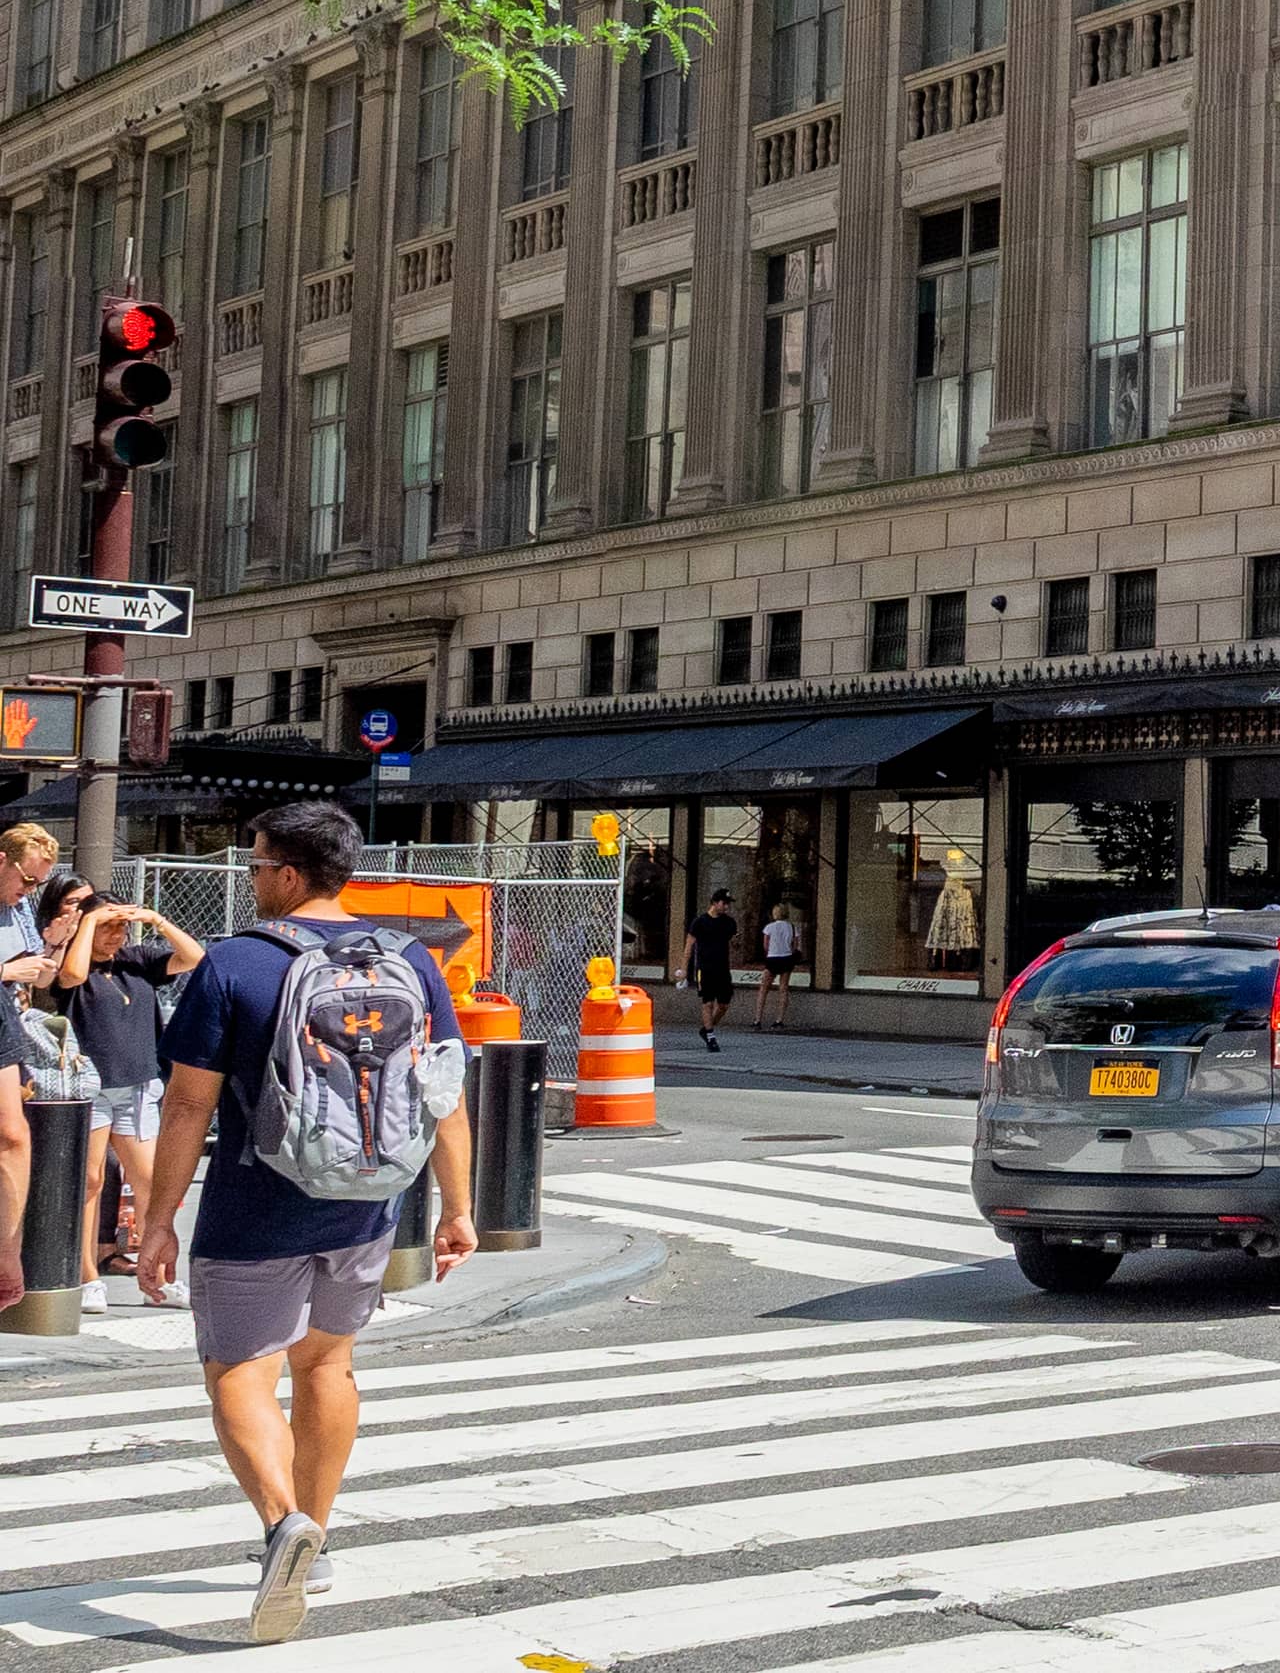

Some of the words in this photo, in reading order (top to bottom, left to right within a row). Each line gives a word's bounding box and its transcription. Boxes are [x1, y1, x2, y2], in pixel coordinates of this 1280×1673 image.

[56, 594, 100, 615] ONE
[122, 599, 167, 620] WAY
[896, 980, 940, 993] CHANEL
[1097, 1070, 1152, 1089] T740380C
